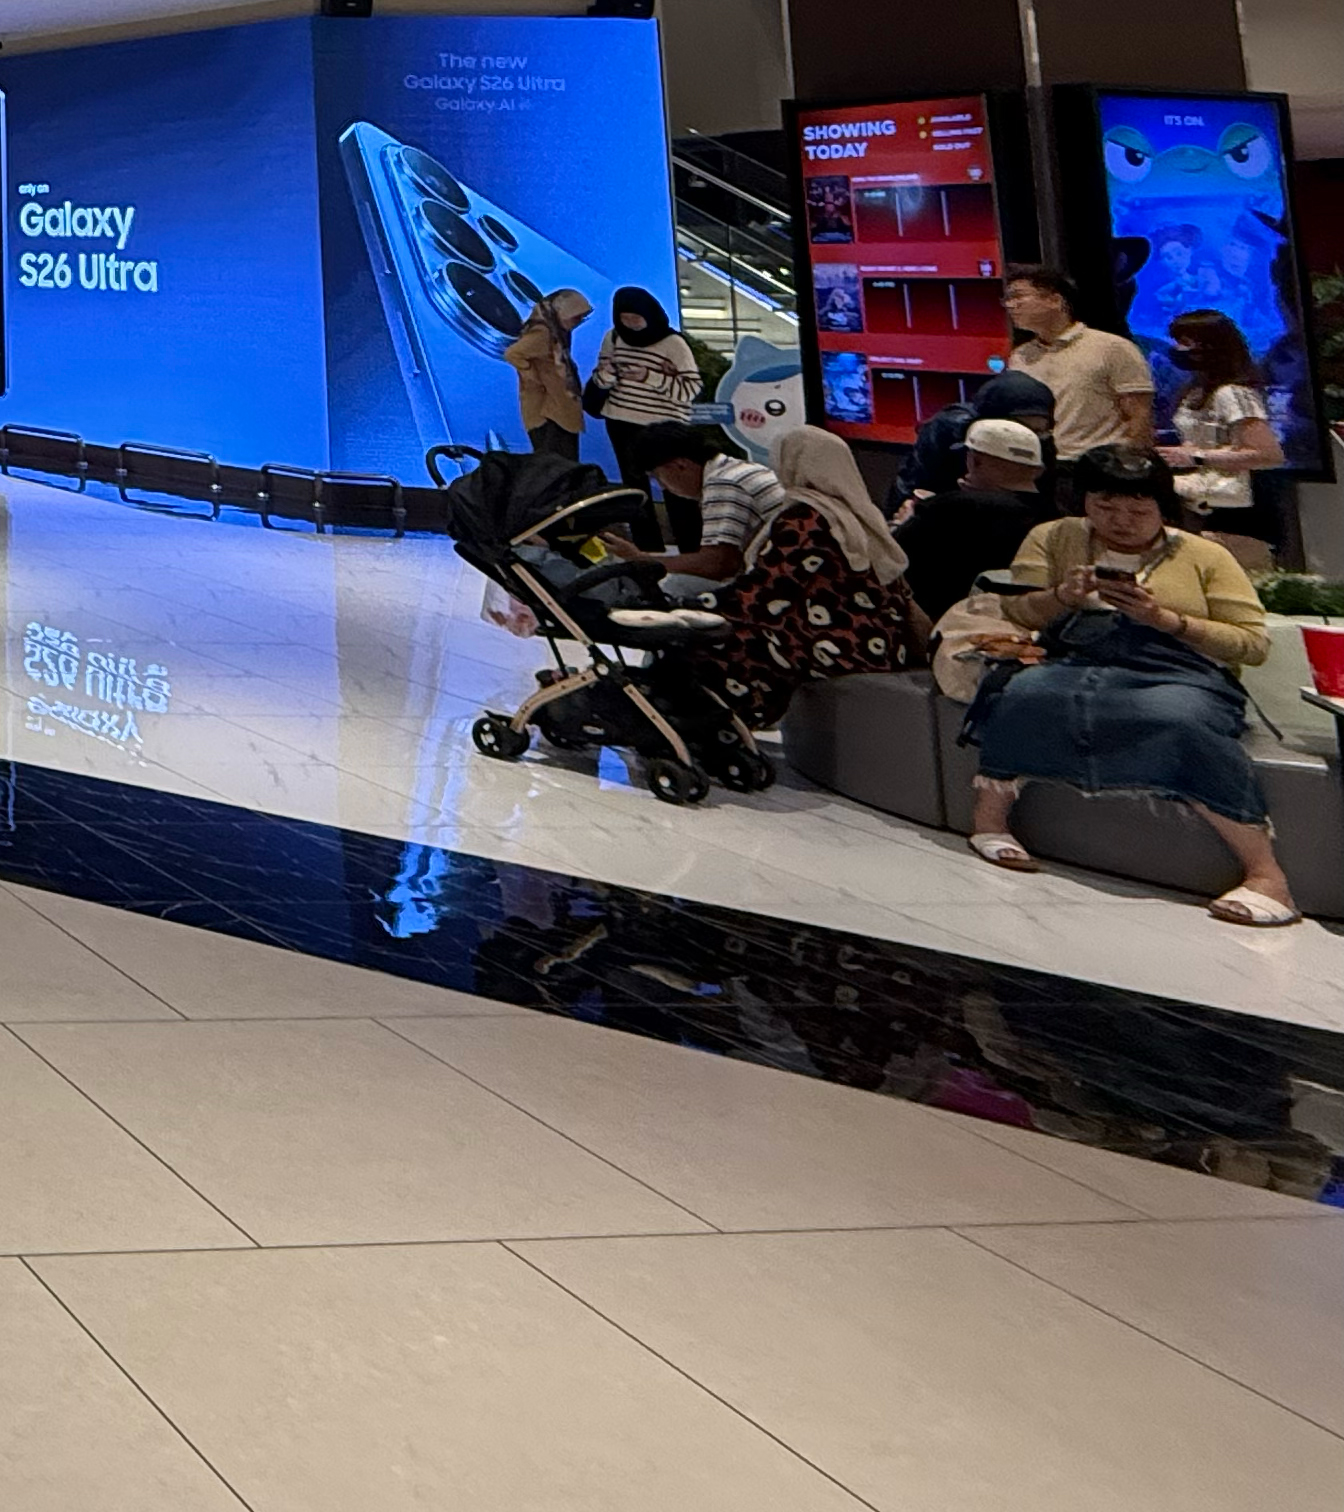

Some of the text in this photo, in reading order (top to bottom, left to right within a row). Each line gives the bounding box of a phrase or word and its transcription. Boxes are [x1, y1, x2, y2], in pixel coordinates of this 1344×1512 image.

[439, 53, 528, 70] The new
[403, 74, 566, 94] Galaxy S26 Ultra
[435, 97, 495, 114] Galaxy
[803, 119, 897, 141] SHOWING
[804, 142, 868, 161] TODAY
[20, 200, 135, 250] Galaxy
[19, 252, 158, 292] S26 Ultra
